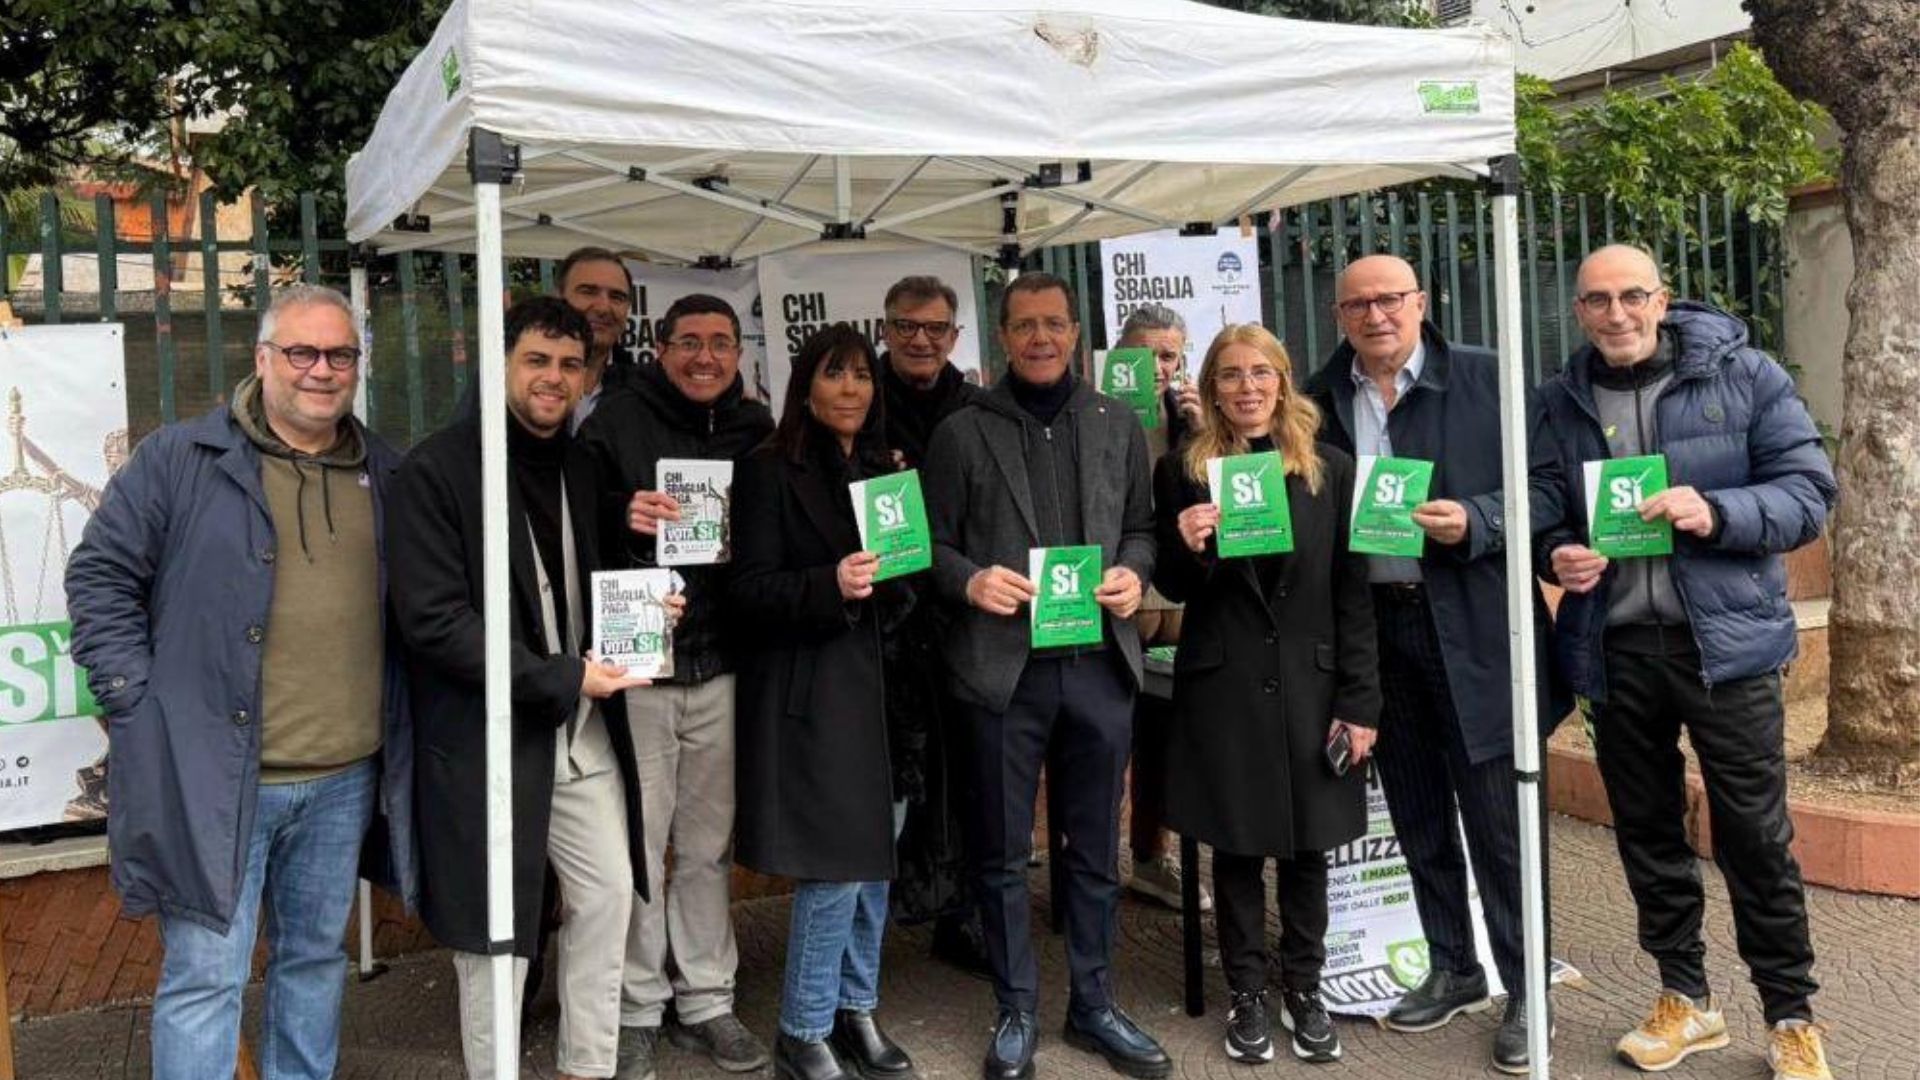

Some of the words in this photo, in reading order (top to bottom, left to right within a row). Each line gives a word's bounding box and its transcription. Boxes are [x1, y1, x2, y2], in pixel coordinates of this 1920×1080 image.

[1112, 252, 1146, 276] CHI
[1113, 275, 1194, 301] SBAGLIA
[783, 292, 826, 323] CHI
[664, 471, 682, 483] CHI
[600, 579, 619, 591] CHI
[1320, 967, 1409, 1003] VOTA
